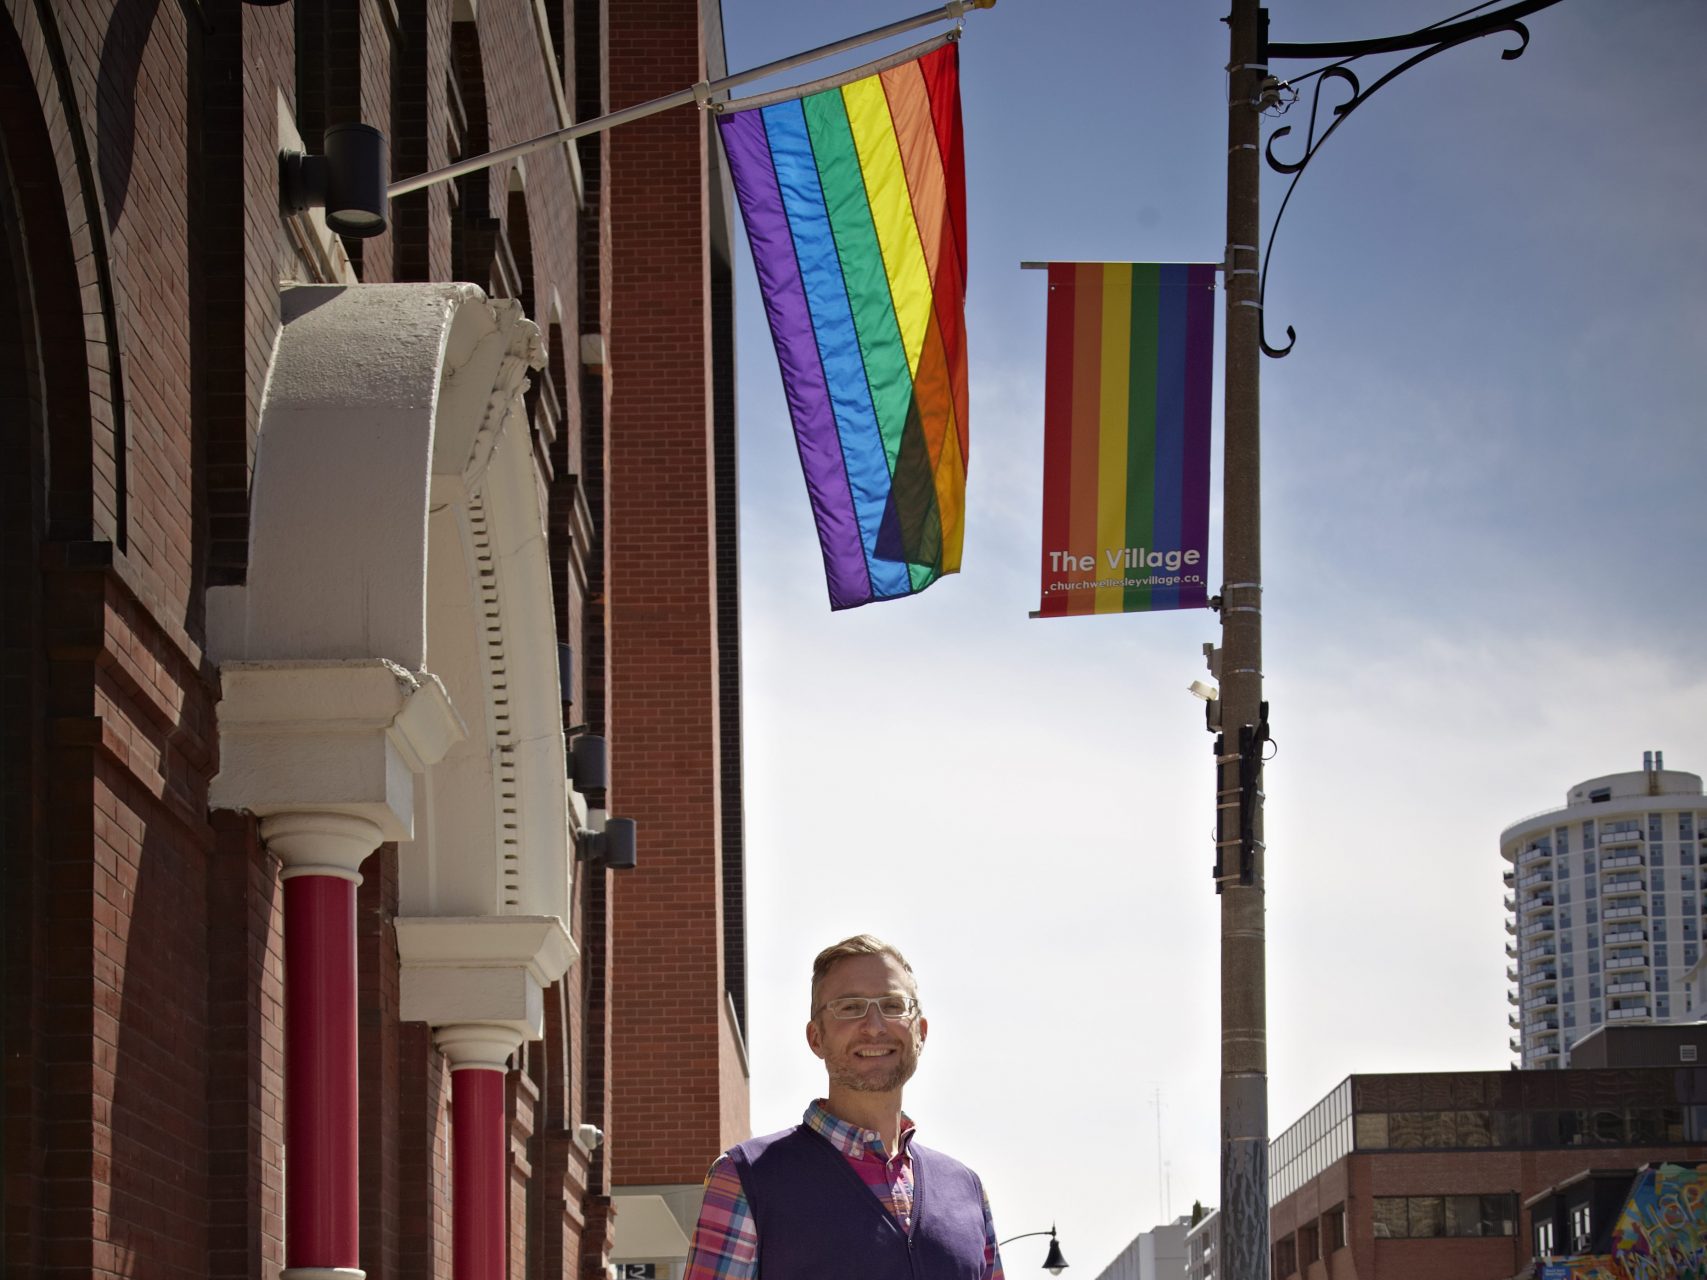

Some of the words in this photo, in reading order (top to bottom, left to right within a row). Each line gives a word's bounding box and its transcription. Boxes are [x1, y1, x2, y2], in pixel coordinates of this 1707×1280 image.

[1049, 551, 1096, 573] The
[1105, 548, 1201, 571] Village
[1050, 574, 1200, 591] churchwellesleyvillage.ca
